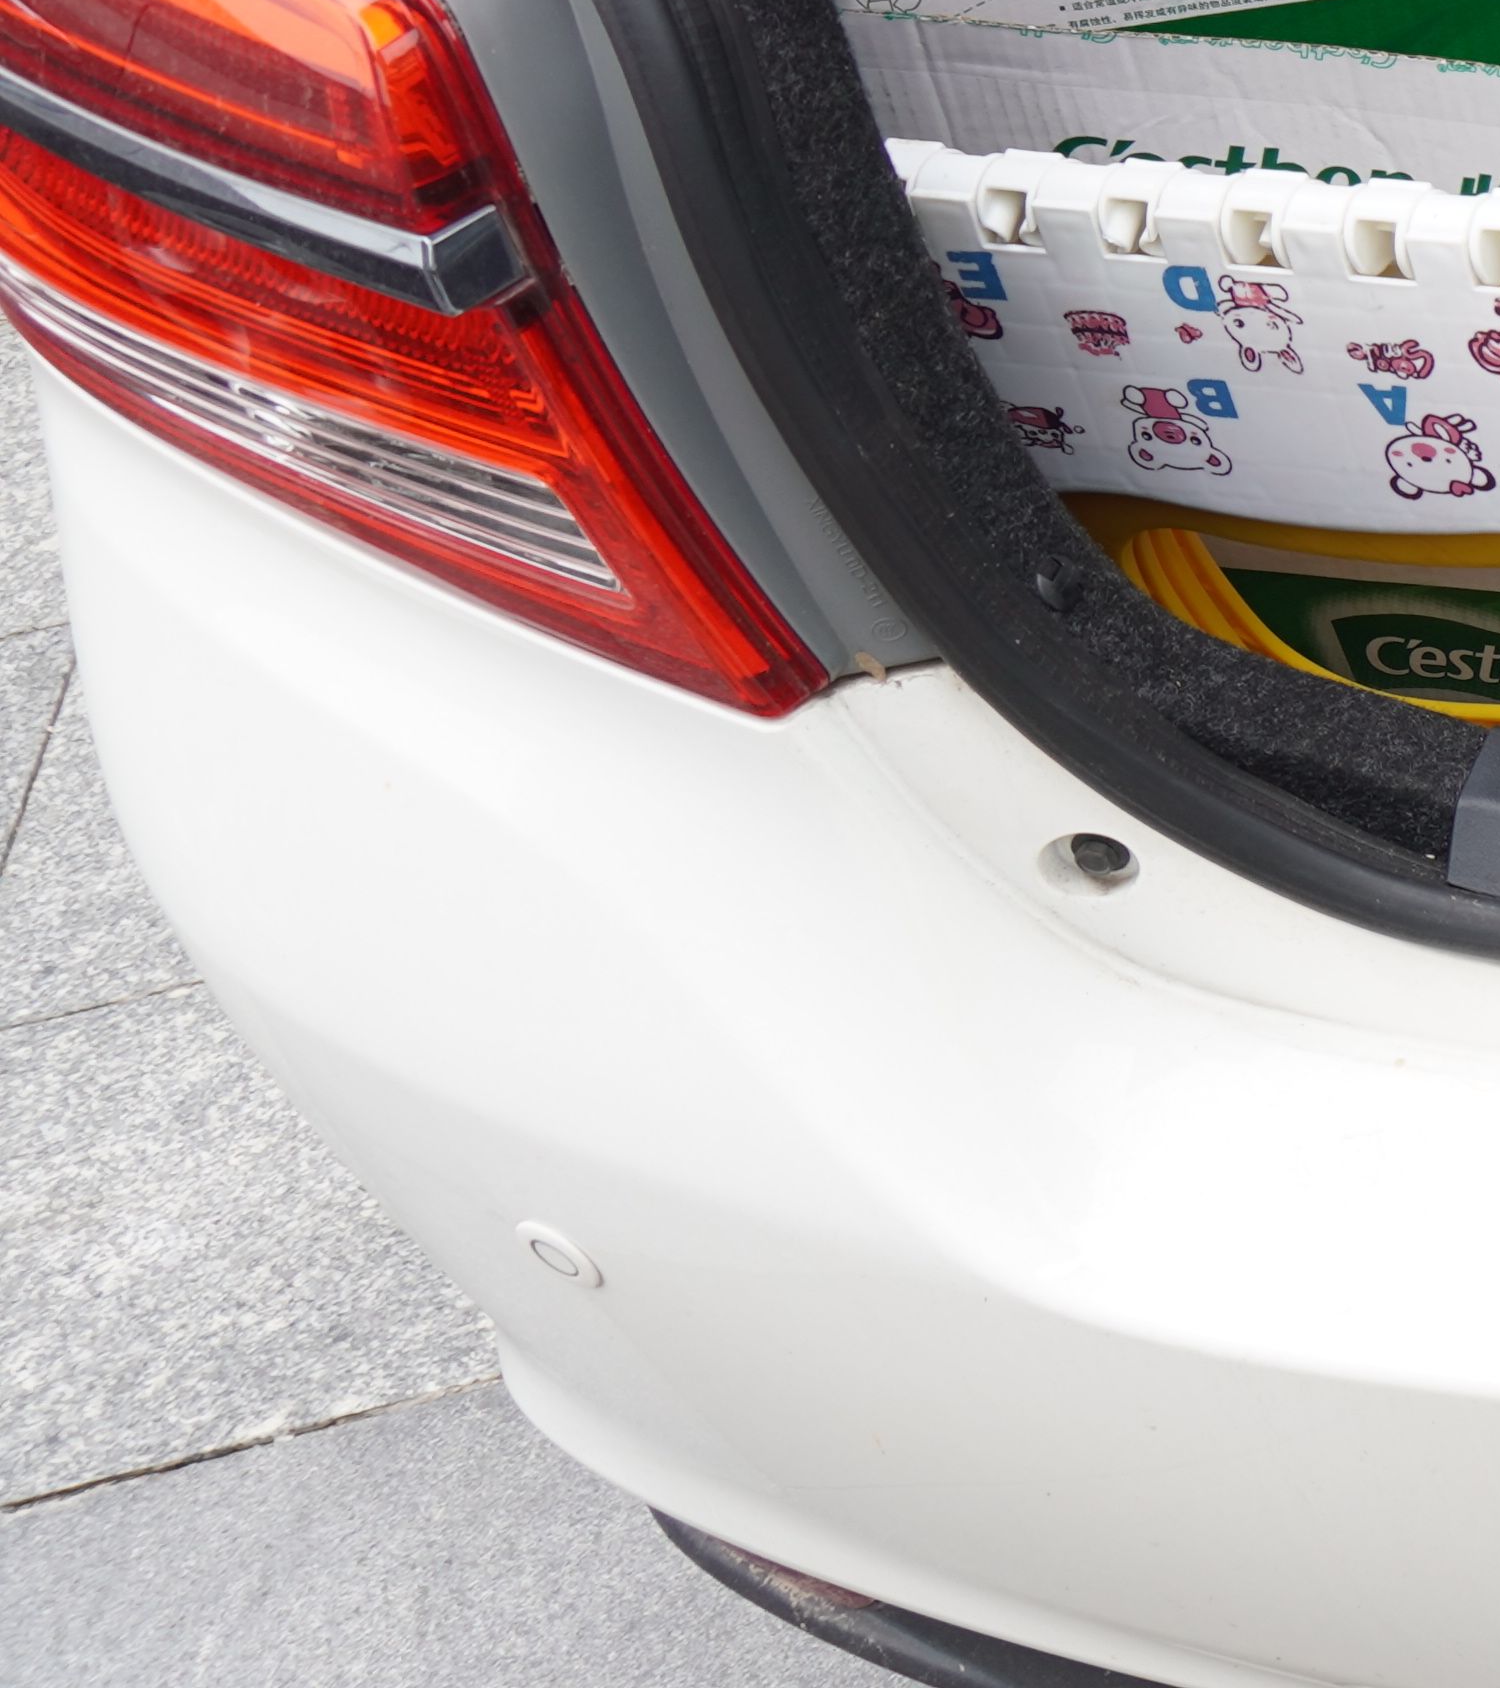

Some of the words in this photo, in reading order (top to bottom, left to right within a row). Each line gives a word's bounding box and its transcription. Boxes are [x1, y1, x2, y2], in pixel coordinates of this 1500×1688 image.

[946, 250, 1008, 302] E
[1162, 265, 1217, 313] D
[1195, 378, 1239, 419] B
[1356, 383, 1408, 426] A
